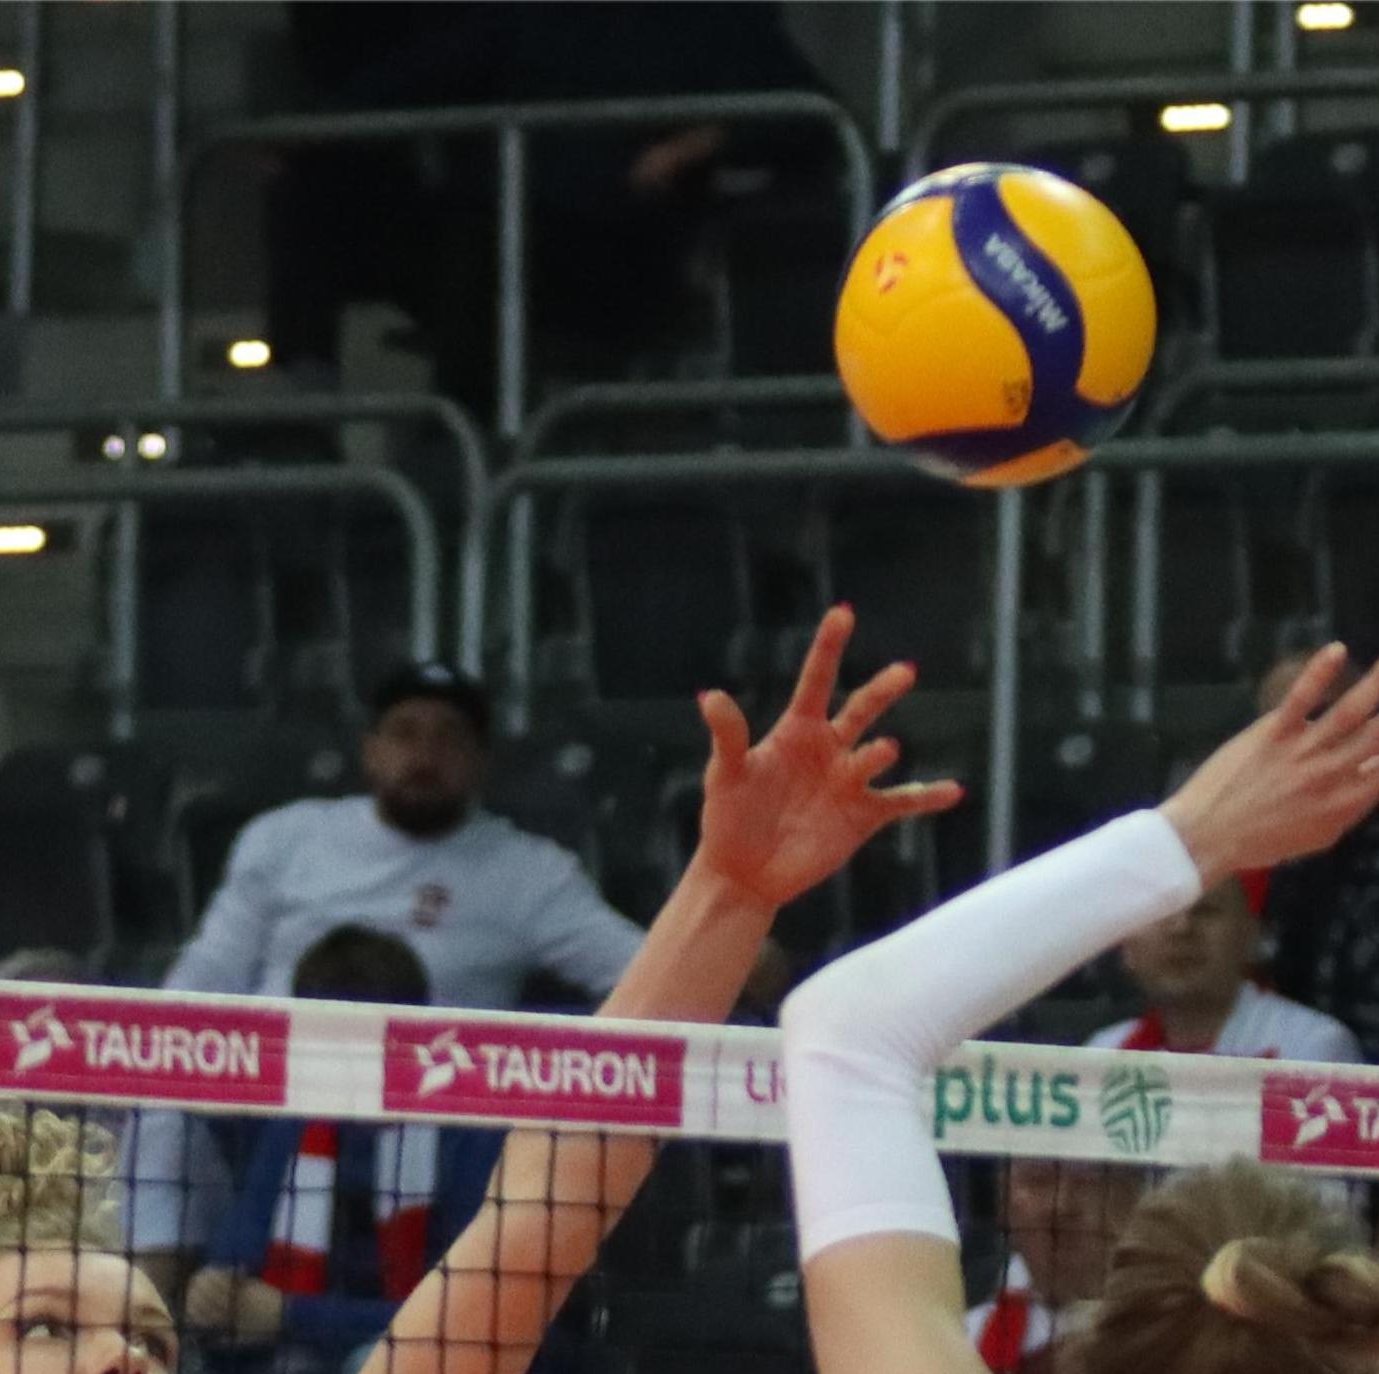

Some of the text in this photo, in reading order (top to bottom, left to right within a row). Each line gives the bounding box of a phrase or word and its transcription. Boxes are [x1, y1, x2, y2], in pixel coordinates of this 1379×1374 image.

[82, 1022, 260, 1079] TAURON
[482, 1043, 657, 1099] TAURON
[746, 1060, 785, 1103] LI
[934, 1054, 1080, 1139] plus
